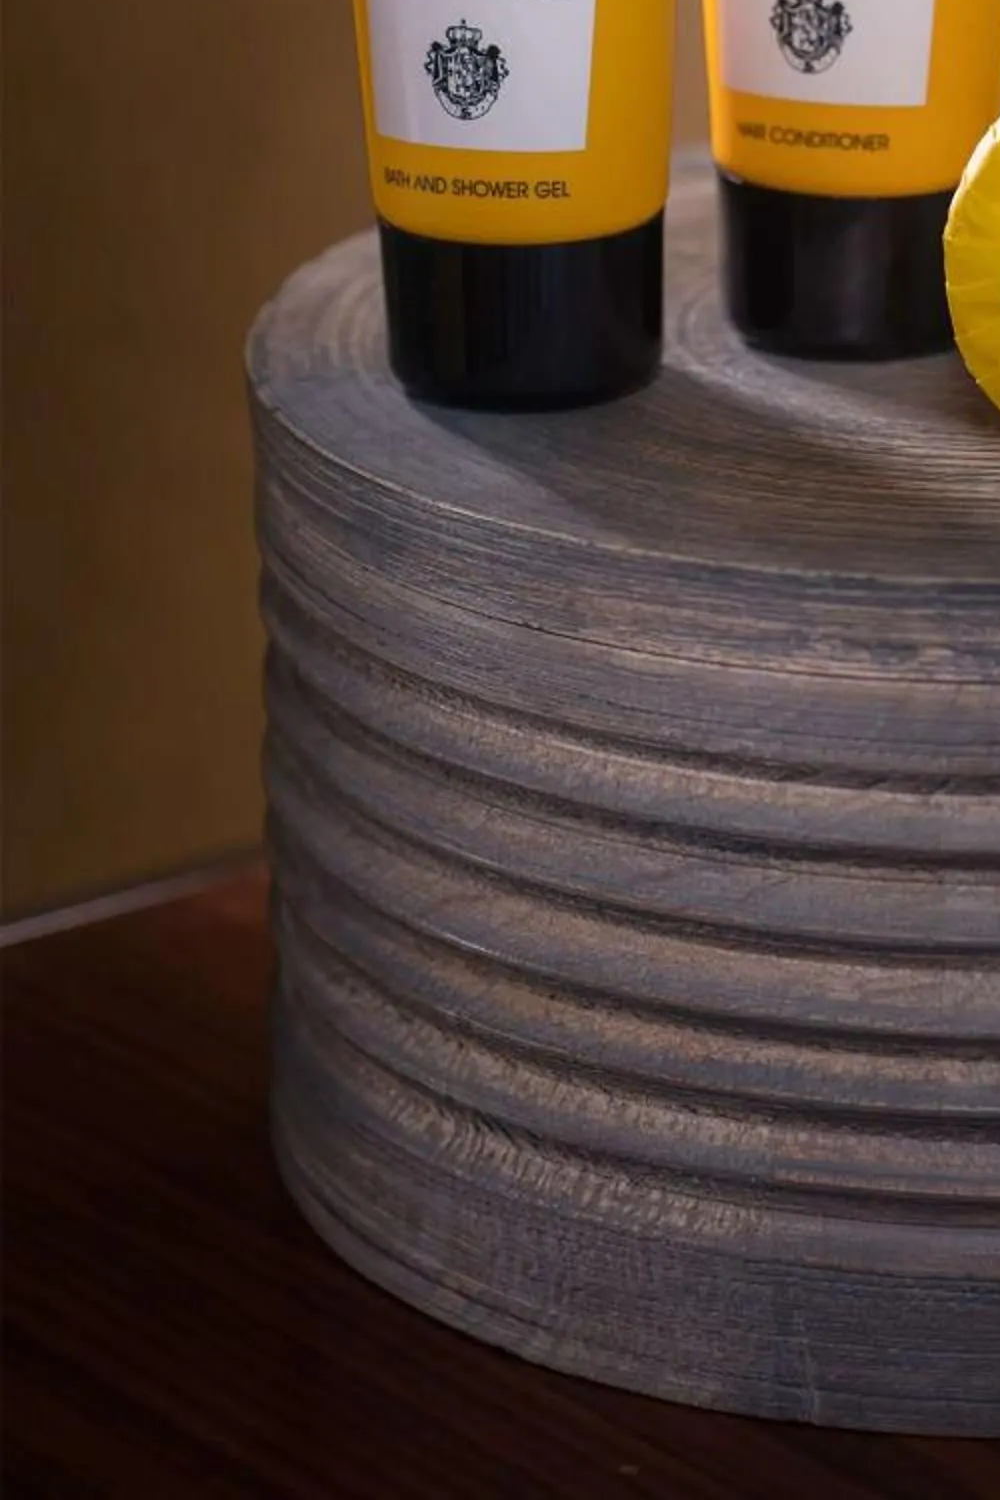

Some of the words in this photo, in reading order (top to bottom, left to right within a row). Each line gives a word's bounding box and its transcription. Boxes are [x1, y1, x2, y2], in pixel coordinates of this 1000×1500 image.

[769, 125, 890, 152] CONDITIONER
[384, 167, 410, 188] BATH
[414, 174, 447, 194] AND
[452, 178, 529, 199] SHOWER
[534, 181, 570, 199] GEL
